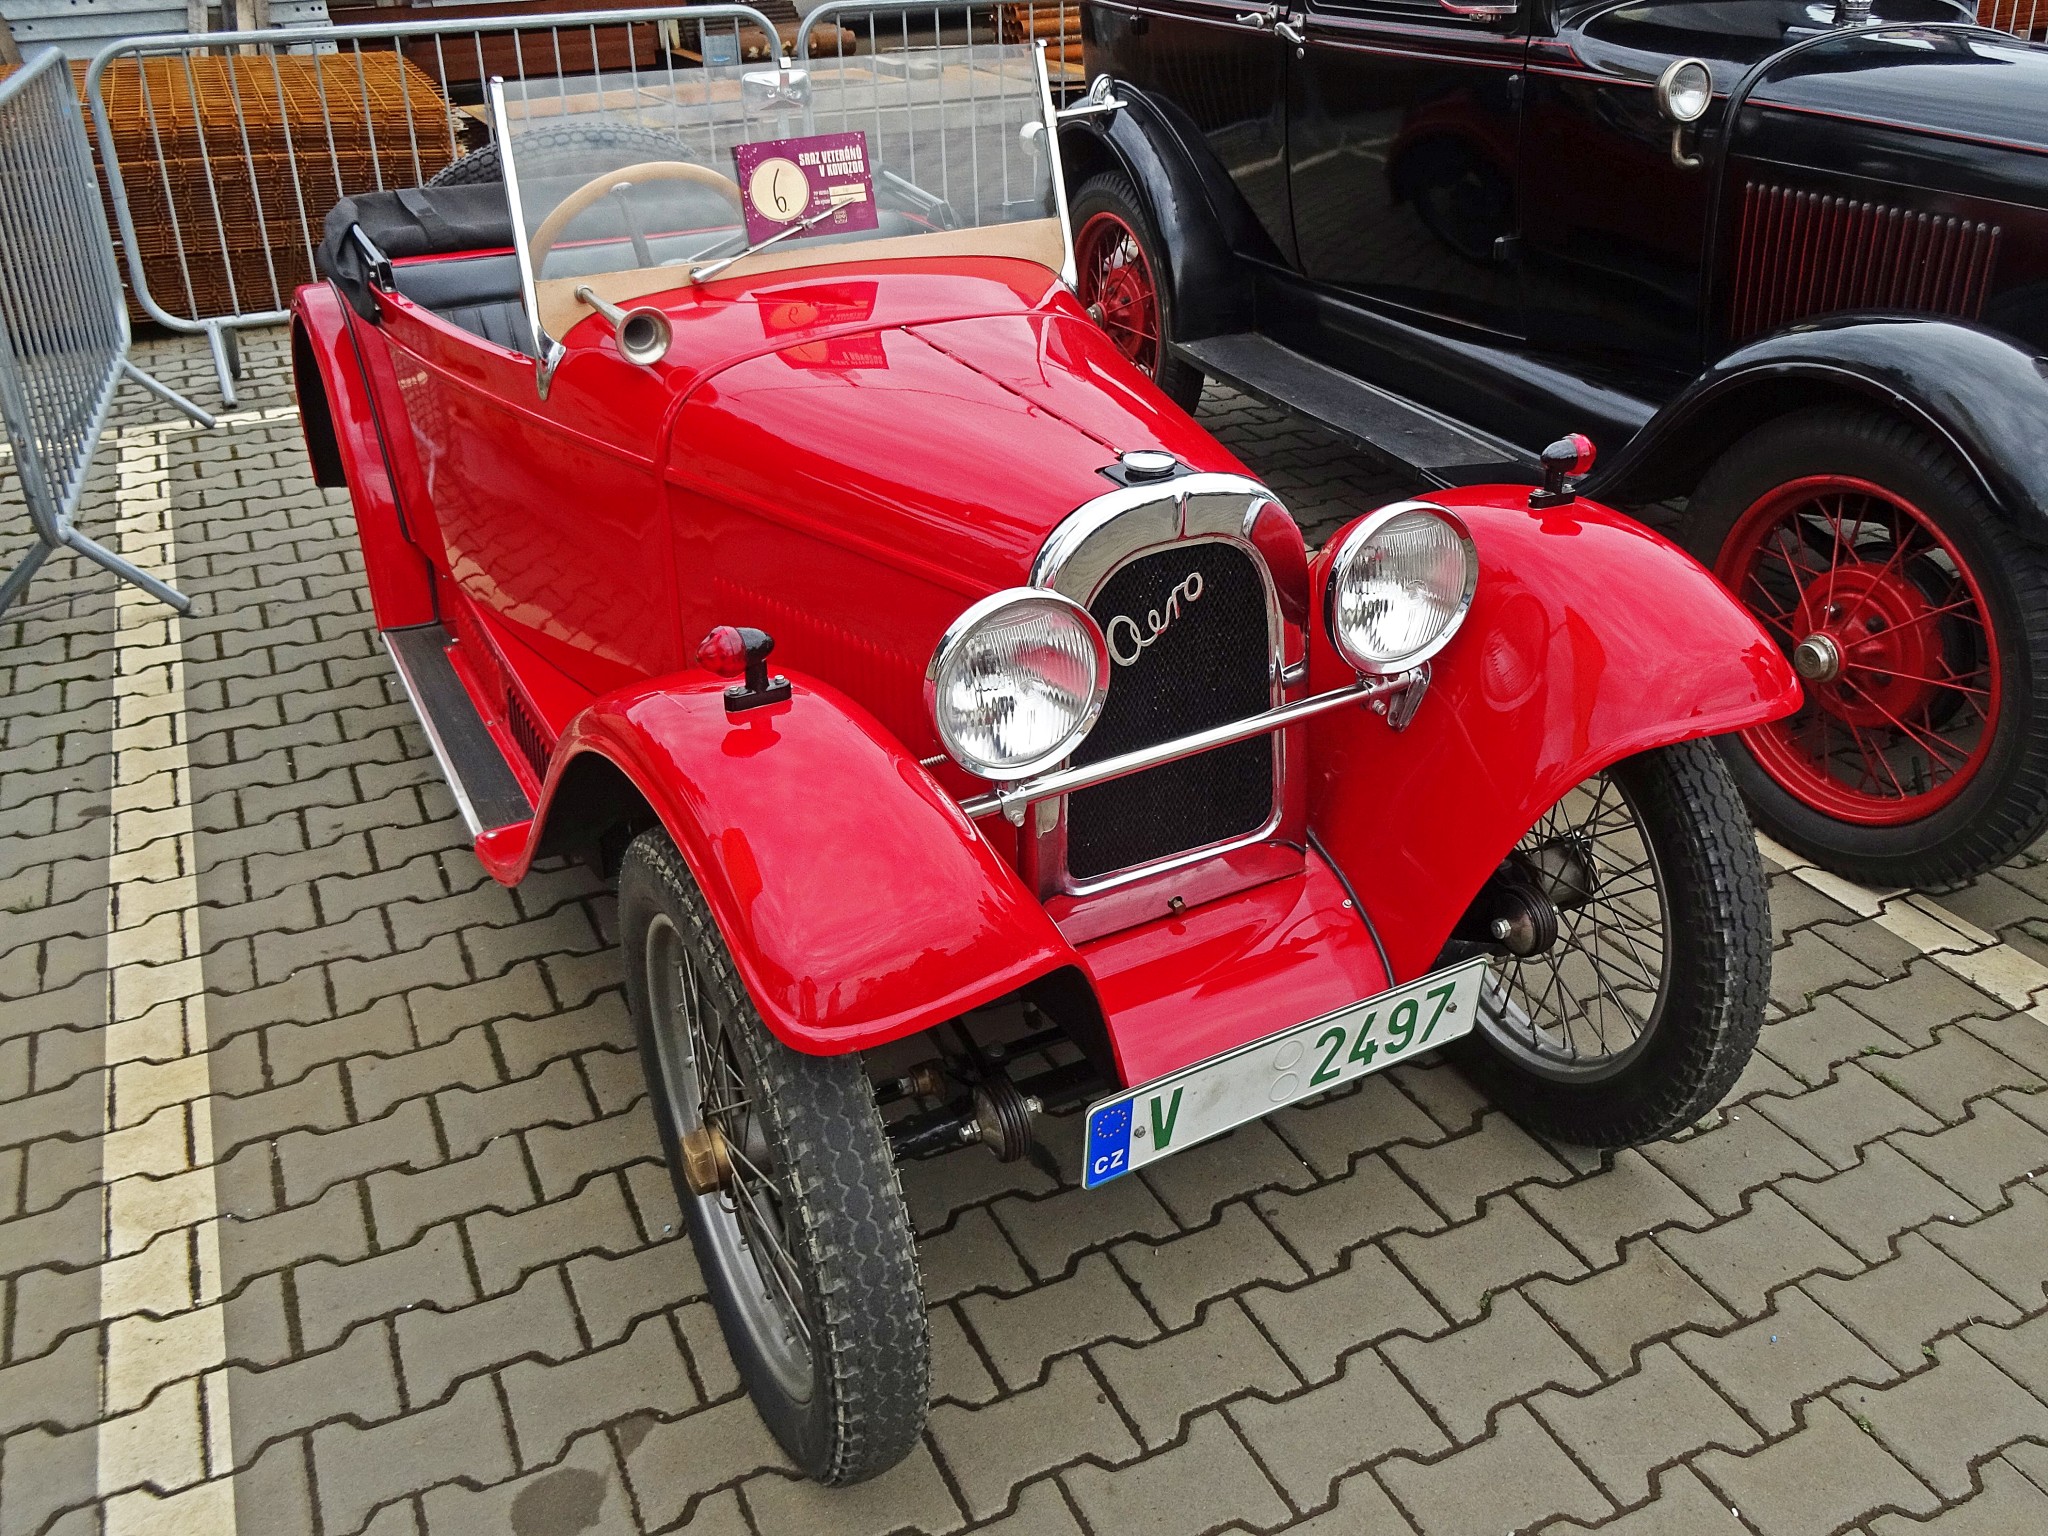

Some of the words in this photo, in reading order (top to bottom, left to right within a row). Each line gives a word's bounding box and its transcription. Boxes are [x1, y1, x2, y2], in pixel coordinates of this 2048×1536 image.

[799, 151, 821, 166] SRAZ
[819, 164, 826, 177] V
[1106, 572, 1204, 667] Aero
[1150, 1086, 1185, 1151] V
[1308, 980, 1457, 1088] 2497
[1094, 1149, 1124, 1176] CZ
